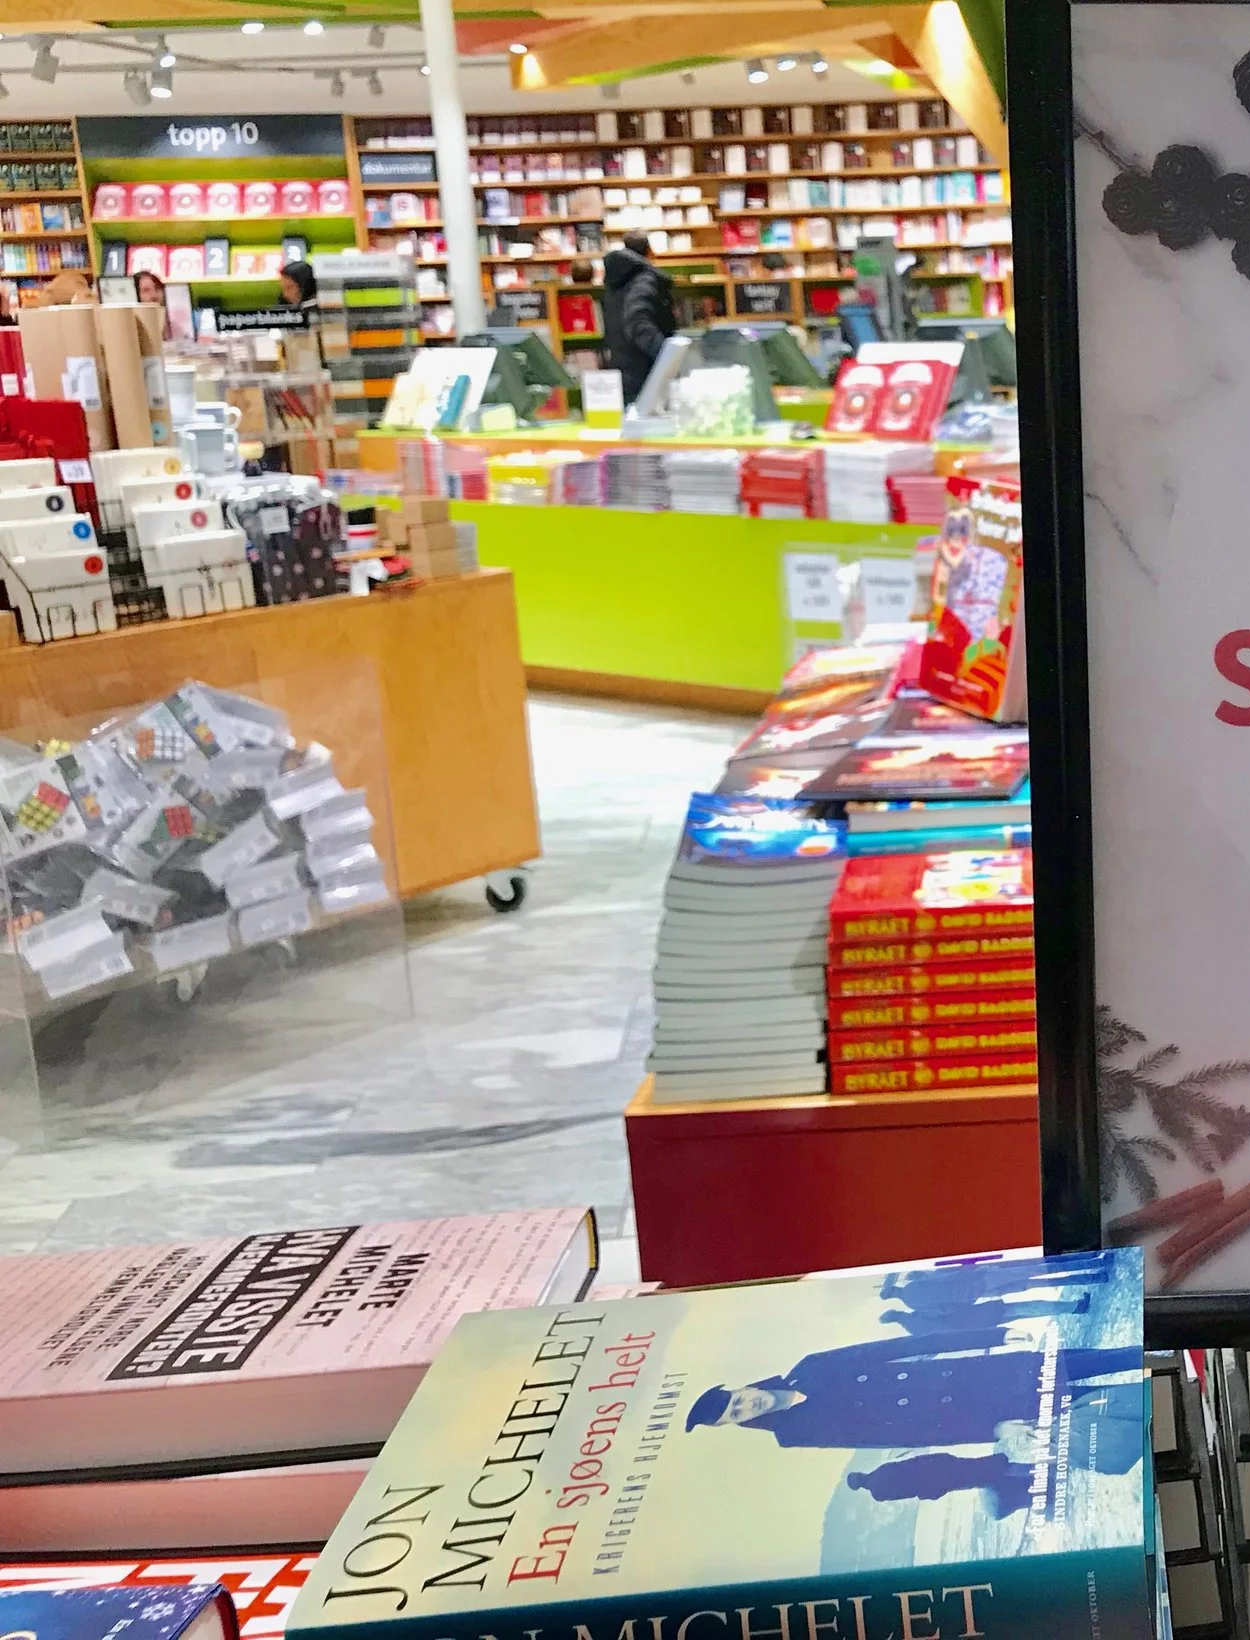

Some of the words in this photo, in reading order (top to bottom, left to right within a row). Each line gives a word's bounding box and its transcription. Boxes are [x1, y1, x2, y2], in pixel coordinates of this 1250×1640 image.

[167, 123, 228, 151] topp
[230, 121, 259, 145] 10
[108, 251, 118, 271] 1
[207, 247, 225, 269] 2
[258, 1228, 351, 1274] HVA
[124, 1234, 286, 1375] HJEMMEFRONTEN?
[143, 1255, 209, 1310] HOLOCAUST
[296, 1244, 393, 1328] MICHELET
[358, 1253, 430, 1311] MARTE
[172, 1273, 303, 1369] VISSTE
[1061, 1395, 1072, 1409] VG
[421, 1310, 607, 1594] MICHELET
[507, 1520, 580, 1588] En
[544, 1401, 627, 1509] sjøens
[588, 1330, 656, 1394] helt
[1055, 1411, 1073, 1480] HOVDENAKK,
[1089, 1422, 1098, 1454] OKTOBER
[593, 1473, 652, 1576] KRIGERENS
[633, 1372, 688, 1463] HJEMKOMST
[1028, 1462, 1049, 1494] finale
[1032, 1495, 1047, 1510] en
[1054, 1482, 1067, 1530] SINDRE
[322, 1484, 445, 1612] JON
[1087, 1570, 1099, 1622] OKTOBER
